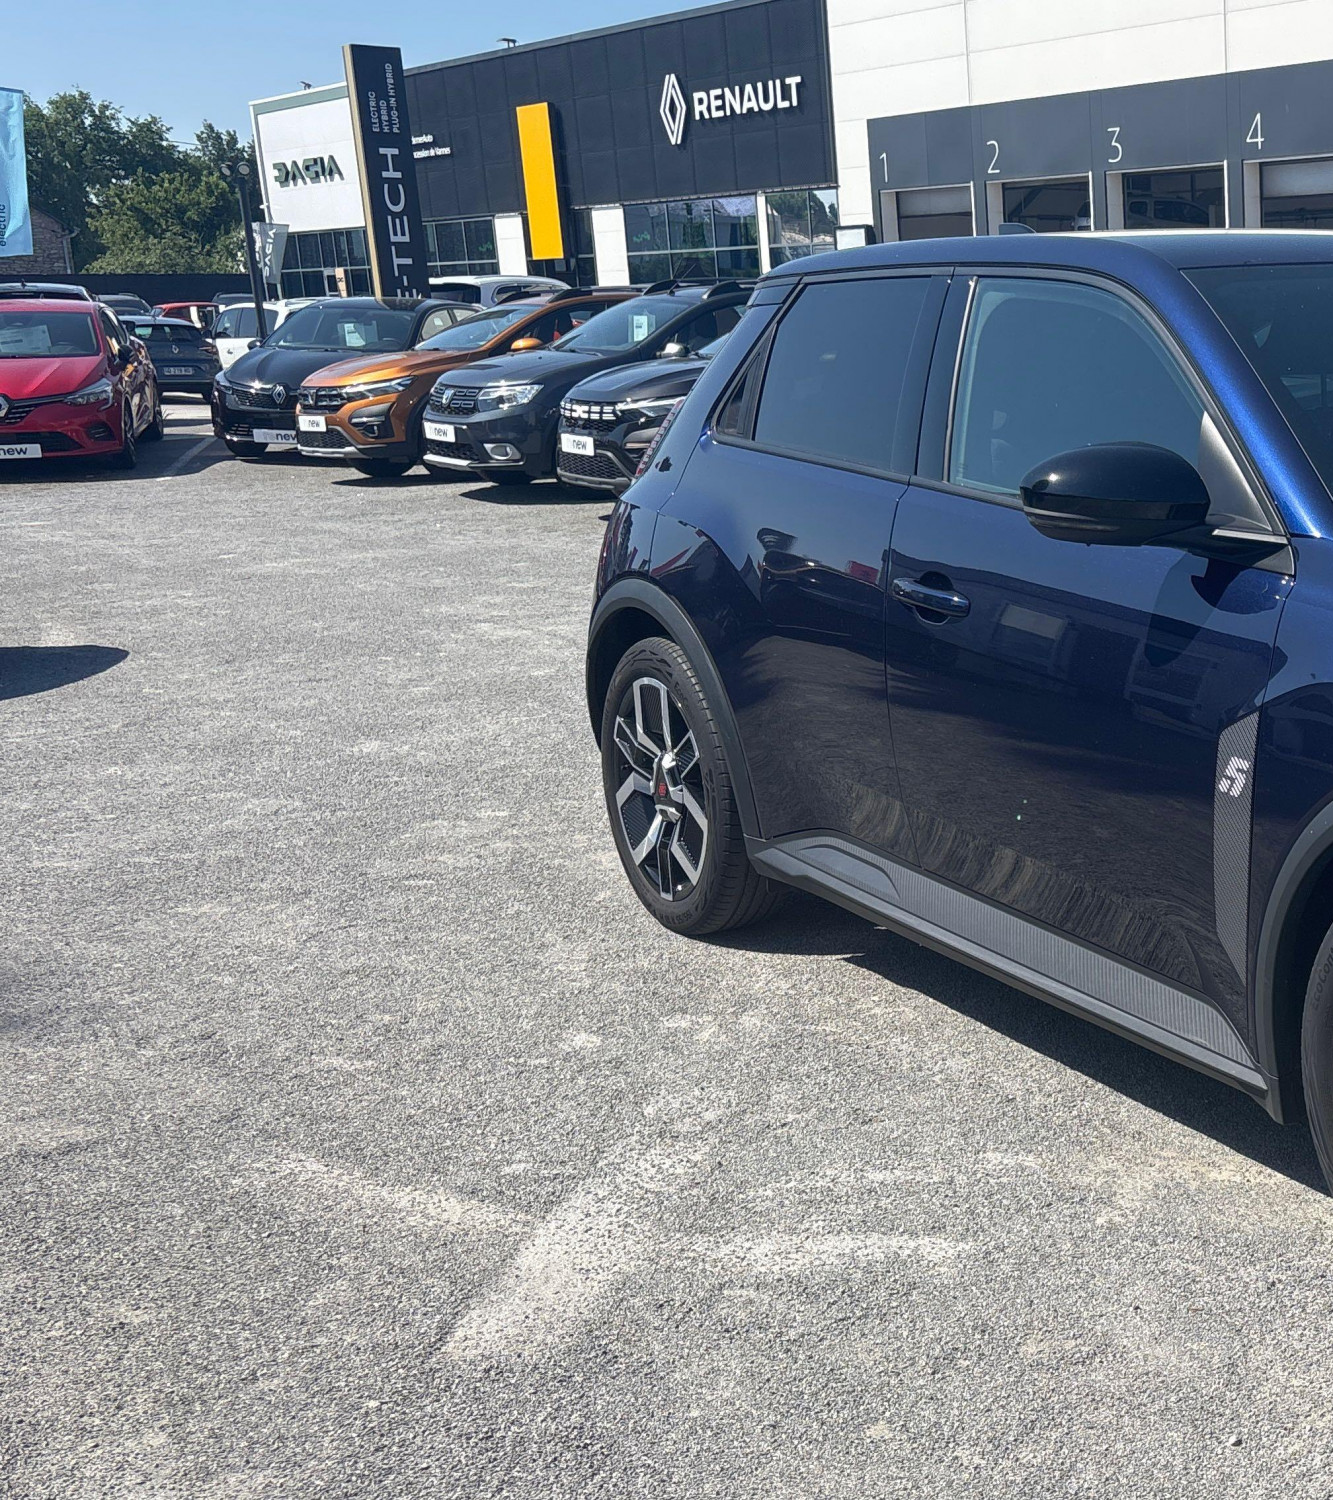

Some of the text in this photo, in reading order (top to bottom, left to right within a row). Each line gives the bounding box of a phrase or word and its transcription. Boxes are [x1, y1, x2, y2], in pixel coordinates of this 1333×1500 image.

[367, 91, 380, 132] ELECTRIC
[379, 100, 390, 133] HYBRID
[385, 63, 400, 133] PLUG-IN HYBRID
[692, 75, 802, 121] RENAULT
[1107, 127, 1123, 164] 3
[1245, 112, 1265, 150] 4
[272, 155, 344, 186] DACIA
[879, 151, 889, 184] 1
[987, 140, 1001, 175] 2
